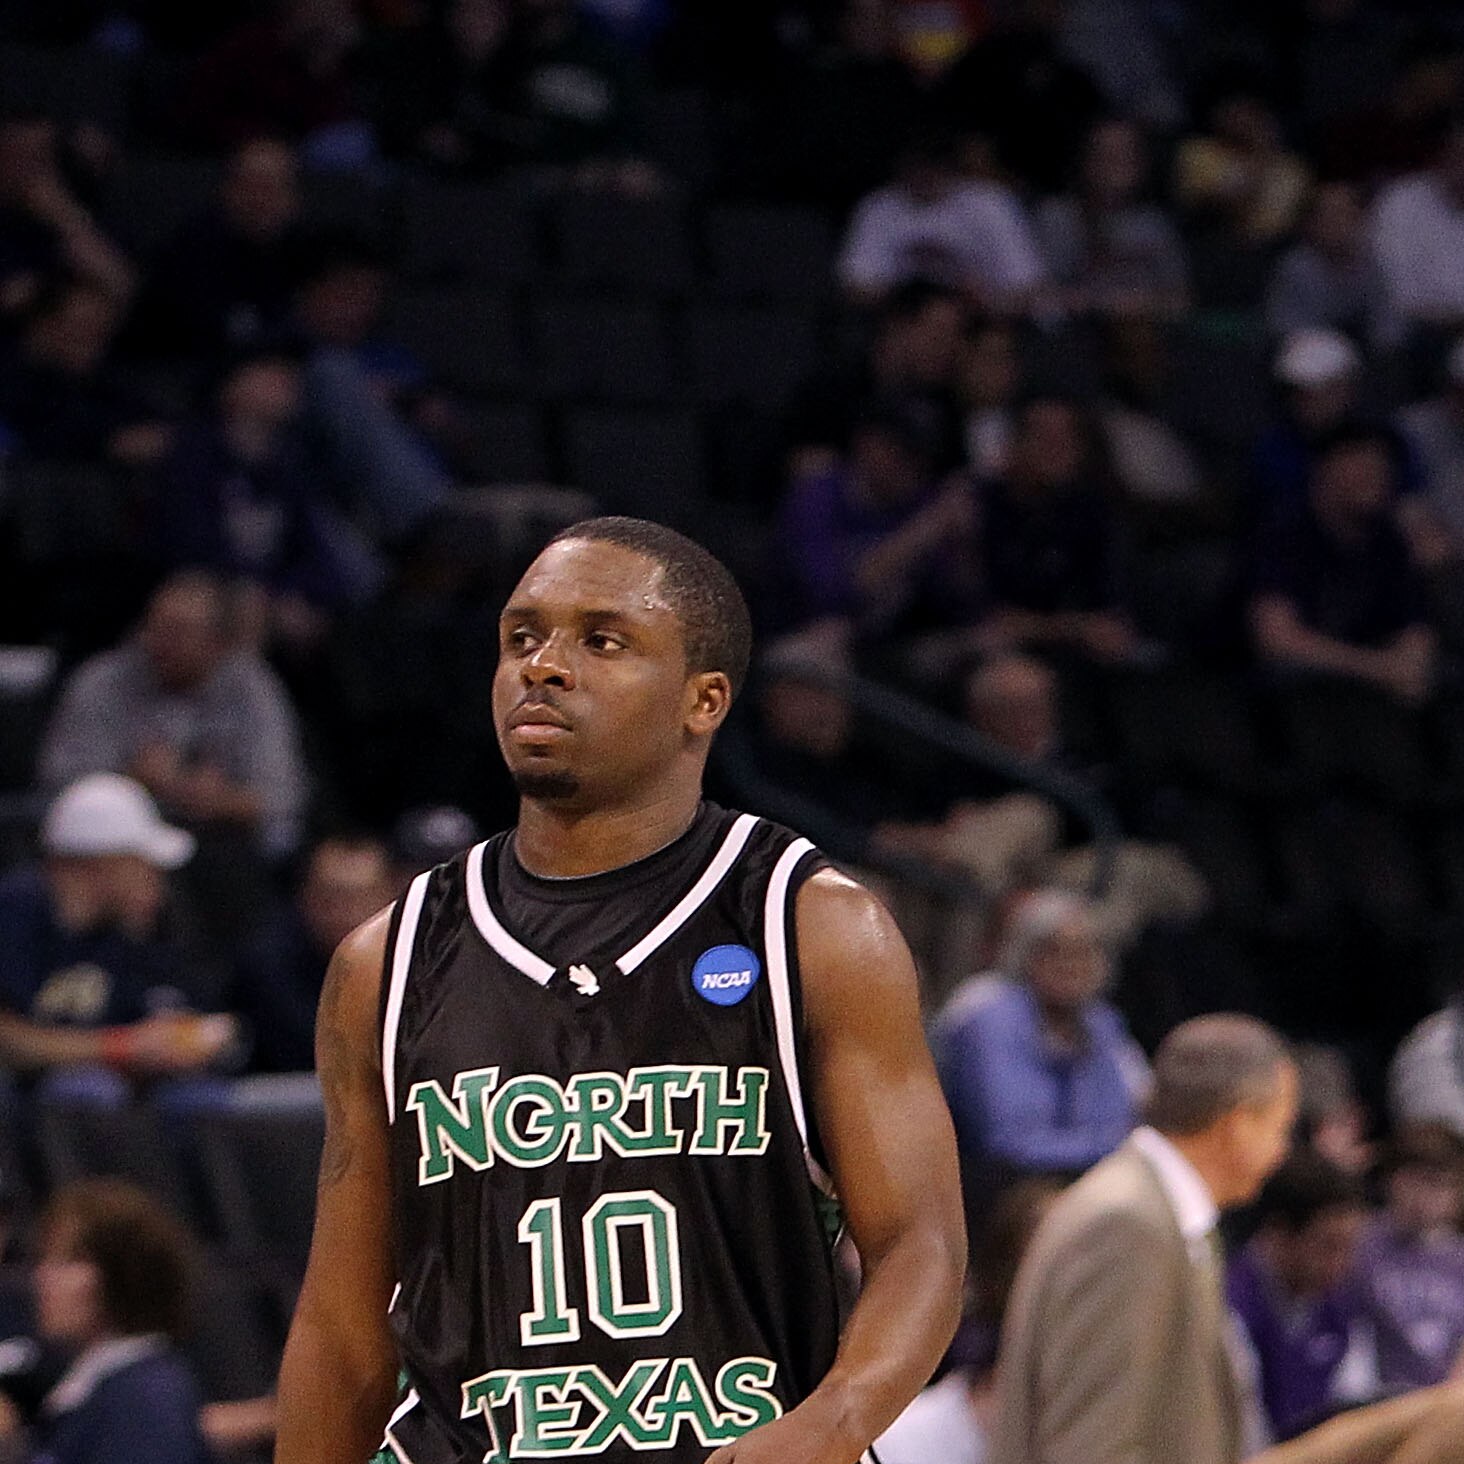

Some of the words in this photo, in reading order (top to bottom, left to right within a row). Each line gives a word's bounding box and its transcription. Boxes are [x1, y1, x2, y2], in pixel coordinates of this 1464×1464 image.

[701, 970, 752, 989] NCAA
[405, 1064, 771, 1186] NORTH
[518, 1190, 683, 1346] 10
